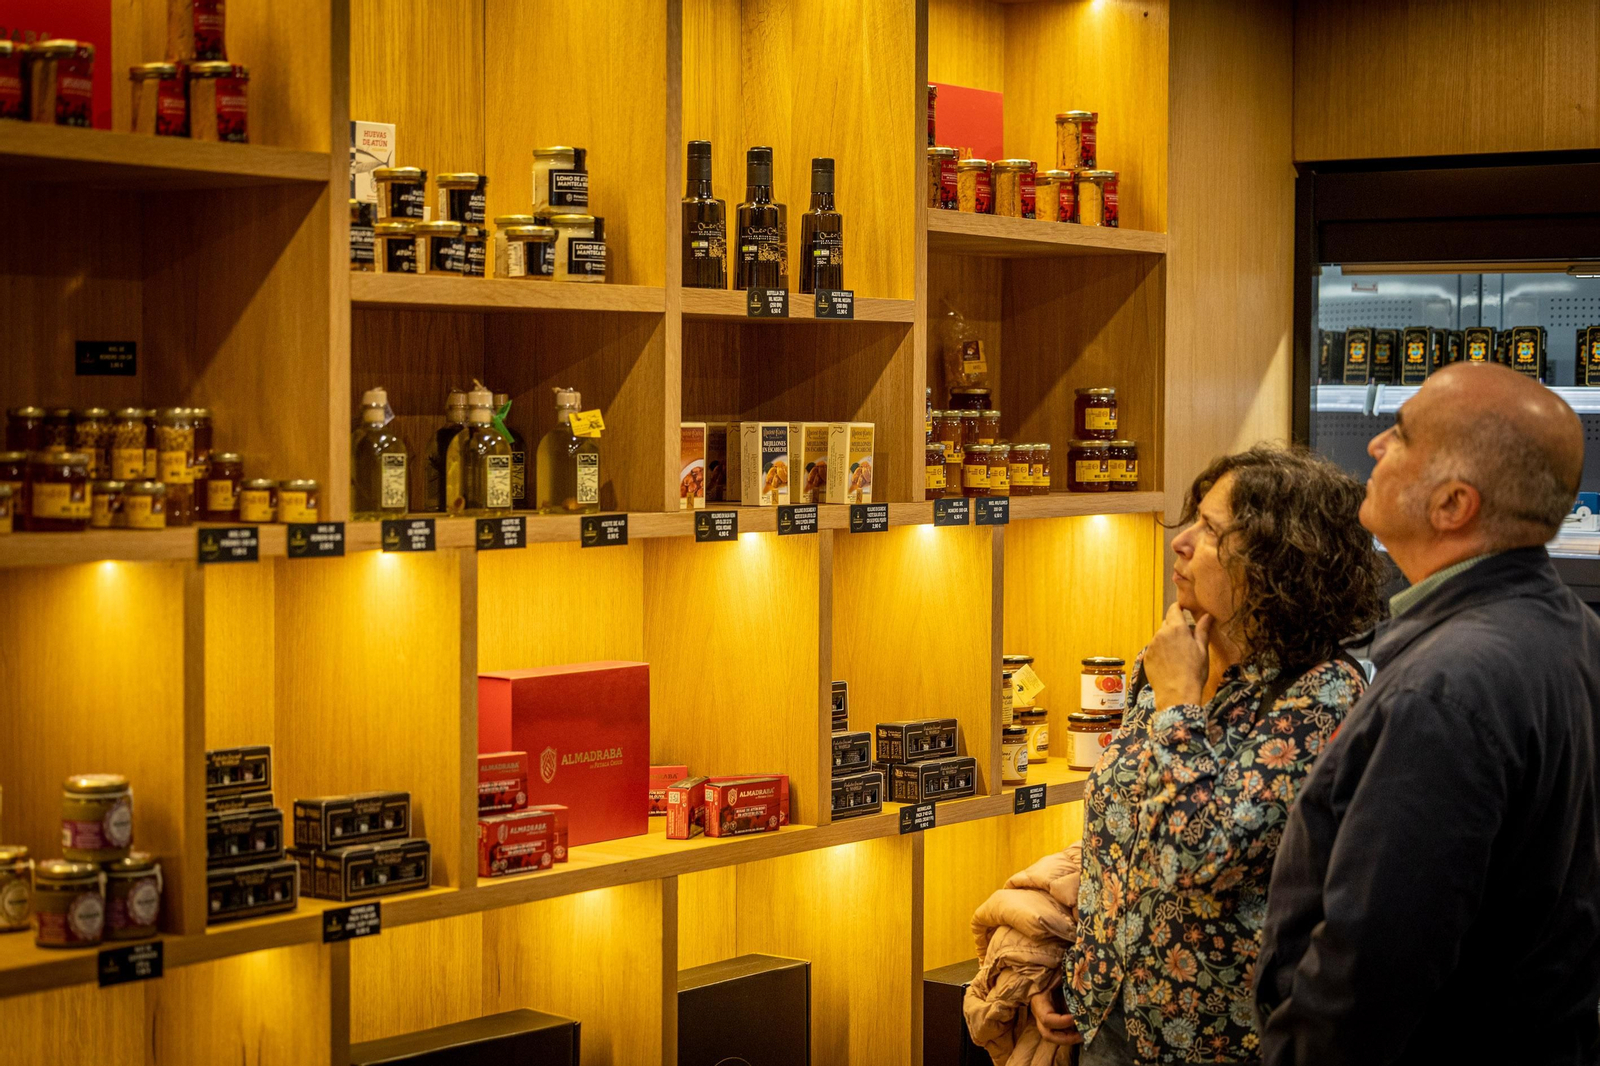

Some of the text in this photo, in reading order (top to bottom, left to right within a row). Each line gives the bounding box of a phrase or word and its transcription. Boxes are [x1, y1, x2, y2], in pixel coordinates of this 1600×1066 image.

[363, 130, 387, 139] HUEVAS
[561, 747, 623, 766] ALMADRABA
[738, 788, 775, 798] ALMADRABA
[509, 823, 547, 834] ALMADRABA
